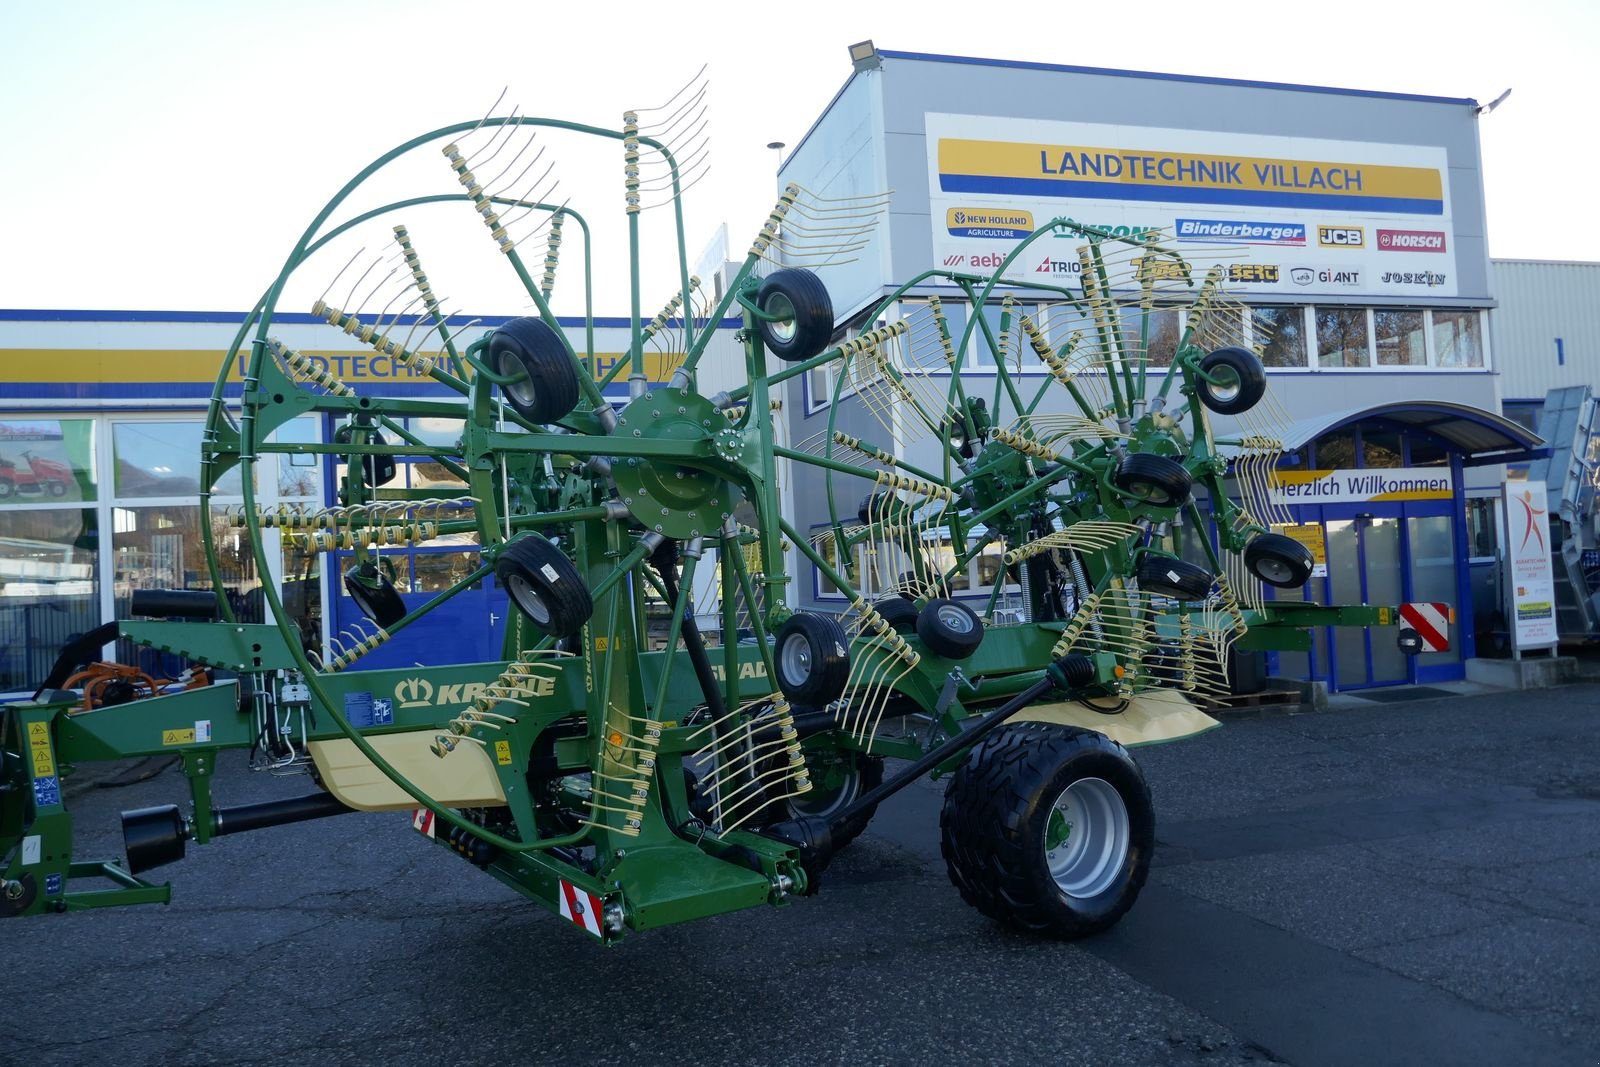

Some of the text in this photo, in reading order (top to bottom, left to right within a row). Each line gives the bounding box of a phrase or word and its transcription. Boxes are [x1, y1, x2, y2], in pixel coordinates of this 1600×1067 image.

[1040, 150, 1363, 191] LANDTECHNIK VILLACH
[967, 215, 1027, 225] NEW HOLLAND
[967, 229, 1014, 238] AGRICULTURE
[1180, 221, 1303, 240] Binderberger
[1320, 229, 1362, 245] JCB
[1391, 234, 1442, 248] HORSCH
[1381, 271, 1446, 286] JOSKIN
[1275, 475, 1448, 497] Herzlich Willkommen
[583, 620, 593, 675] KRON
[436, 677, 556, 706] KRNE
